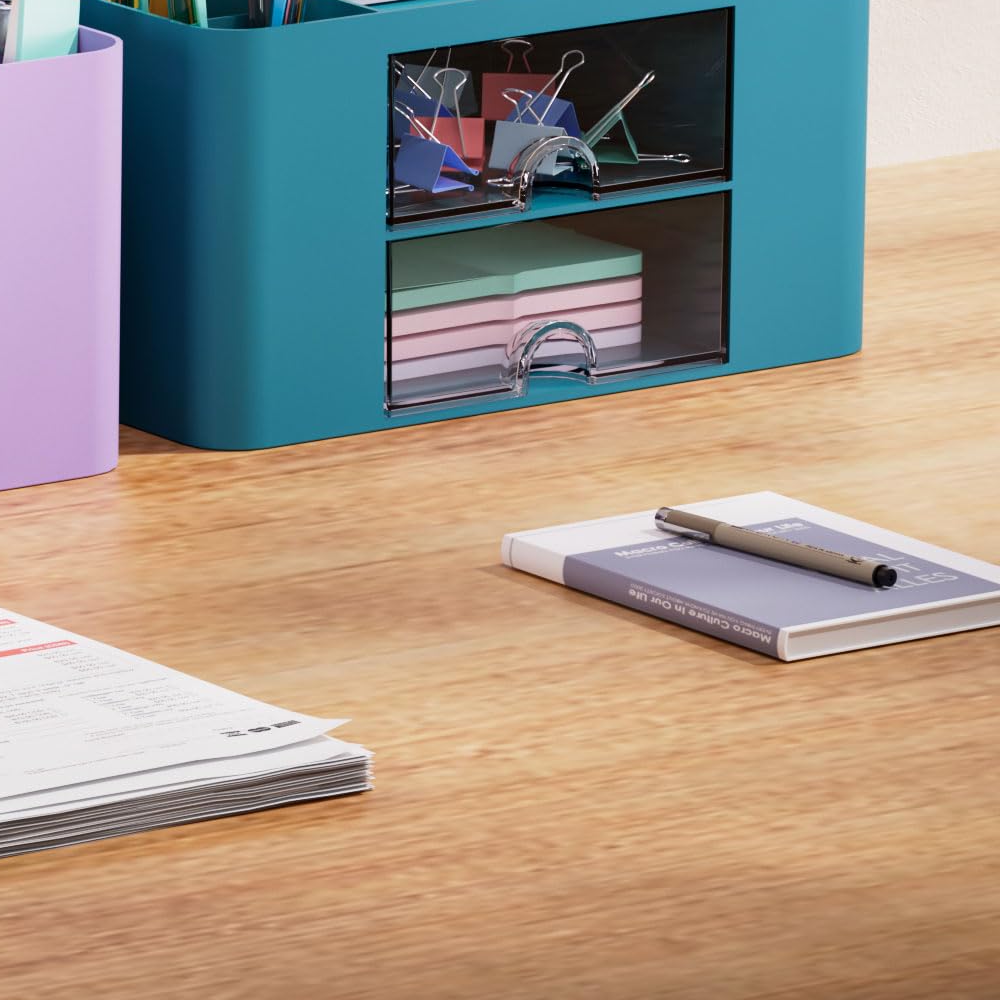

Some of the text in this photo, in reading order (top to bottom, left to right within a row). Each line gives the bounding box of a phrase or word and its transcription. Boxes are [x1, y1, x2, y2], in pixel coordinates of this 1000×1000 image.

[628, 588, 771, 644] Macro Culture In Our Life
